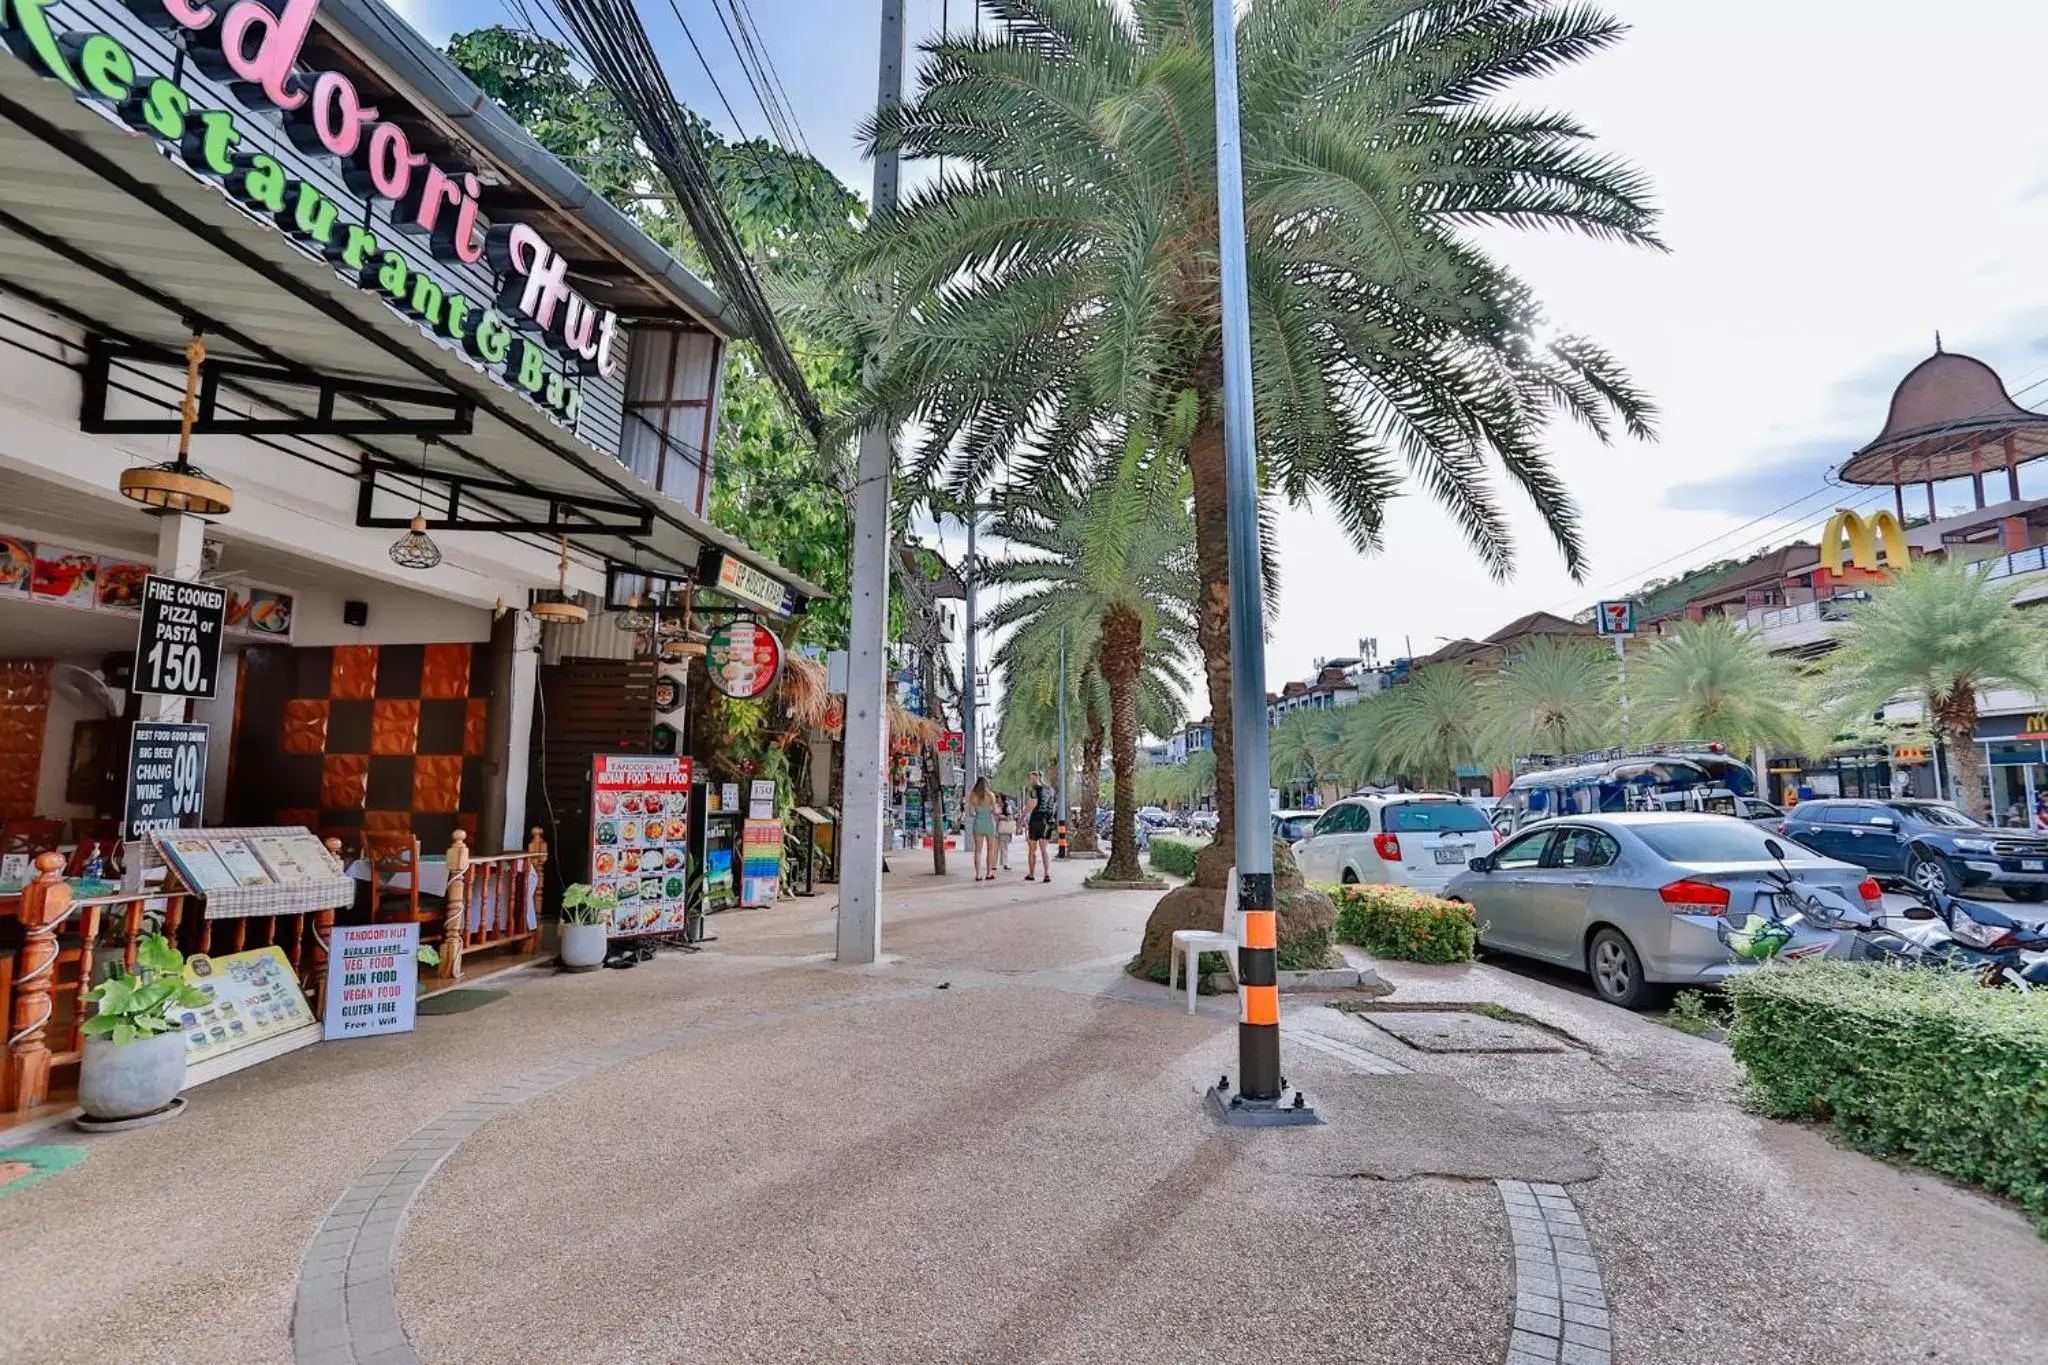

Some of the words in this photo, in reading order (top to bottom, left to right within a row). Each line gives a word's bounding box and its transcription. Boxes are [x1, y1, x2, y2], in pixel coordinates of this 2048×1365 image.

[163, 0, 483, 264] doori
[509, 223, 618, 378] Hut
[476, 309, 513, 363] &
[518, 339, 583, 421] Bar
[148, 581, 175, 603] FIRE
[177, 586, 222, 610] COOKED
[159, 604, 198, 625] PIZZA
[156, 623, 198, 644] PASTA
[200, 621, 214, 633] or
[136, 730, 153, 741] BEST
[154, 731, 171, 741] FOOD
[171, 731, 188, 741] GOOD
[139, 747, 152, 758] BIG
[154, 747, 173, 759] BEER
[136, 764, 172, 780] CHANG
[668, 773, 689, 785] FOOD
[136, 784, 164, 800] WINE
[141, 803, 155, 815] or
[344, 930, 388, 941] TANDOORI
[390, 928, 407, 939] HUT
[343, 945, 382, 956] AVAILABLE
[370, 957, 394, 969] FOOD
[344, 973, 366, 986] JAIN
[371, 971, 397, 984] FOOD
[343, 988, 373, 1001] VEGAN
[378, 986, 401, 998] FOOD
[342, 1003, 373, 1017] GLUTEN
[377, 1002, 396, 1014] FREE
[344, 1021, 367, 1030] Free
